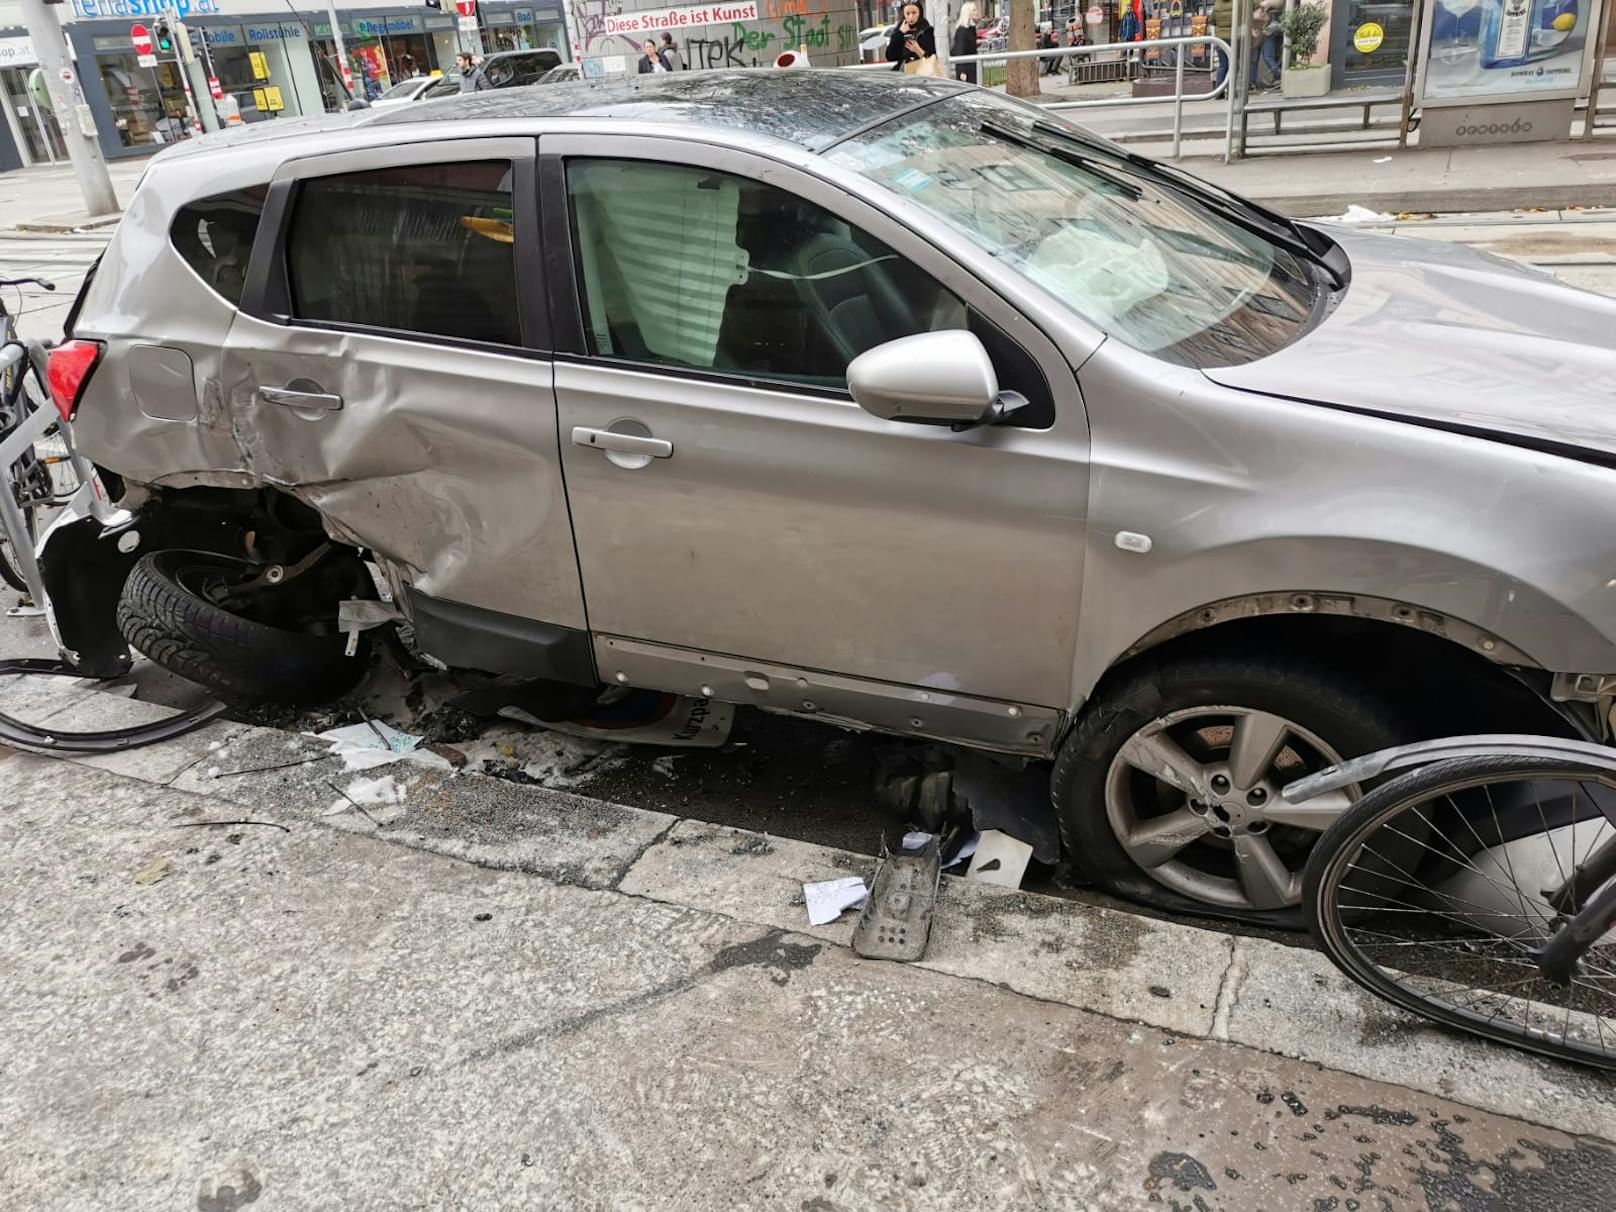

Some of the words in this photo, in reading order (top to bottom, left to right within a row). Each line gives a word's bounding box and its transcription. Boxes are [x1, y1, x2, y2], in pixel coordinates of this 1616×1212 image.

[606, 17, 639, 33] Diese
[641, 11, 688, 29] Straße
[690, 9, 709, 23] ist
[712, 4, 755, 20] Kunst
[199, 31, 236, 44] obile
